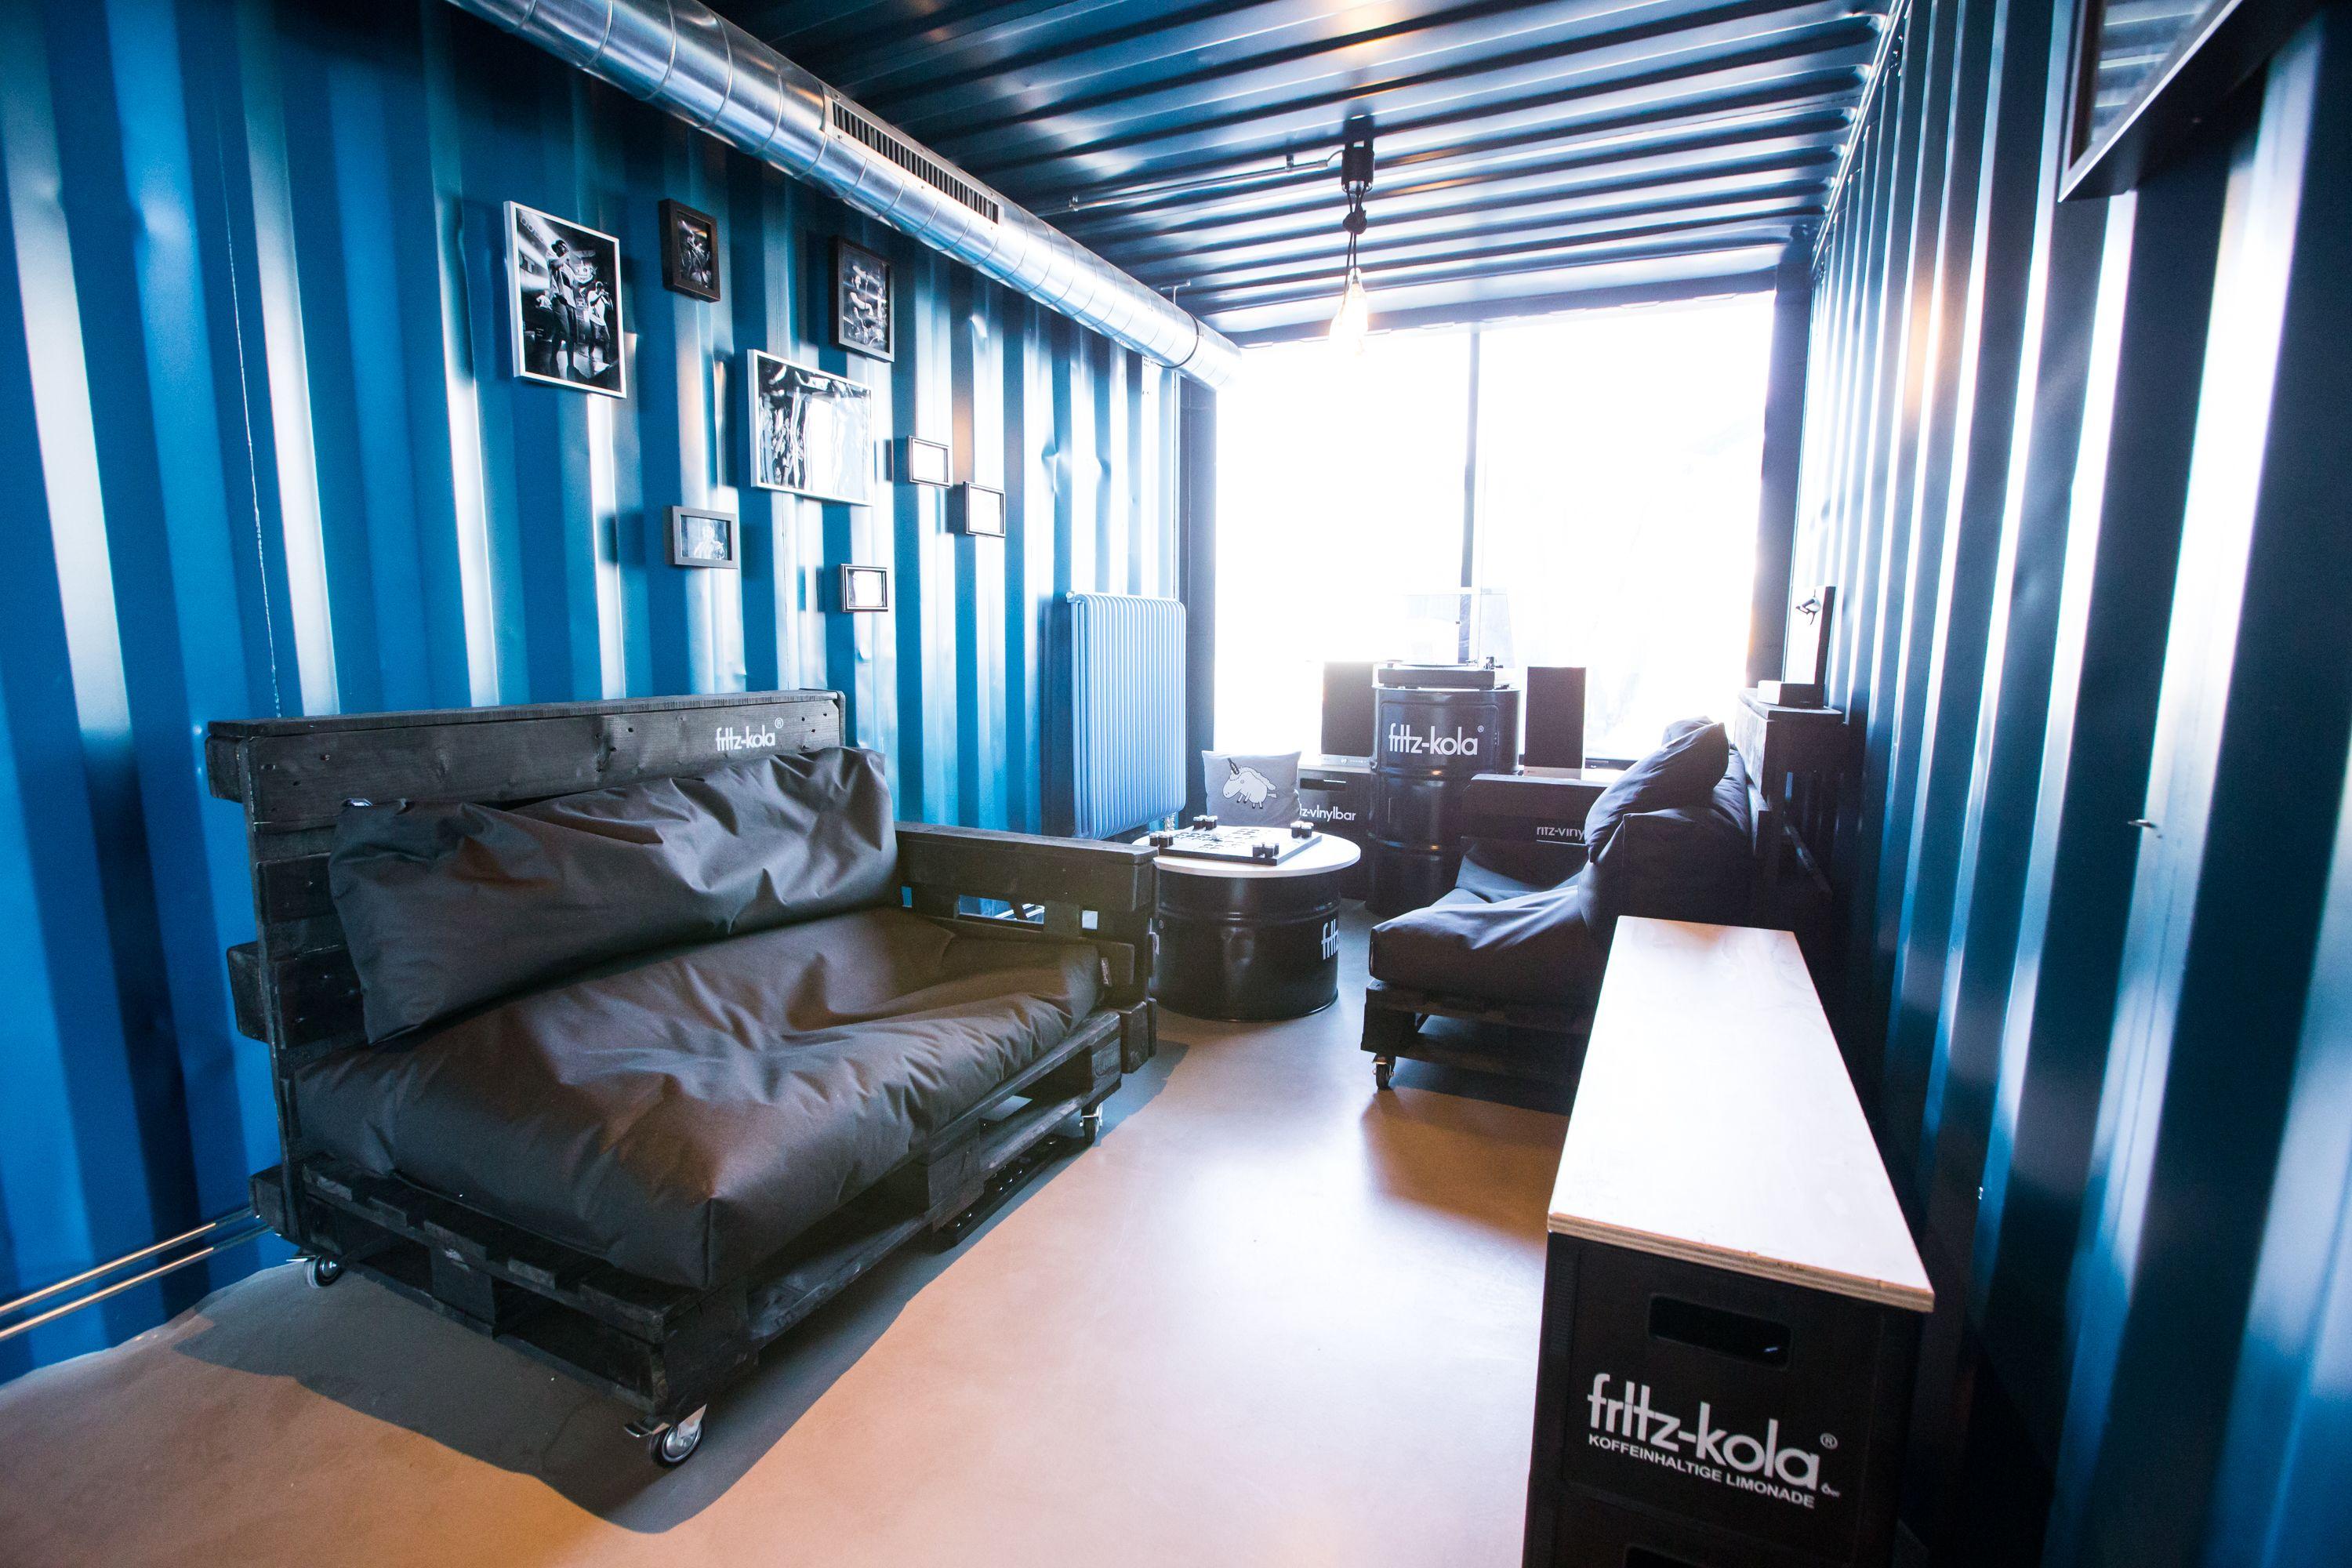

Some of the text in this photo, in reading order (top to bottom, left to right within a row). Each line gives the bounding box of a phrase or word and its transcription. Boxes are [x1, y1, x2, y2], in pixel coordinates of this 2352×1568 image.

[715, 724, 775, 751] fritz-kola
[1388, 722, 1479, 755] fritz-kola
[1587, 1373, 1820, 1490] fritz-kola
[1588, 1433, 1815, 1509] KOFFEINHALTIGE LIMONADE
